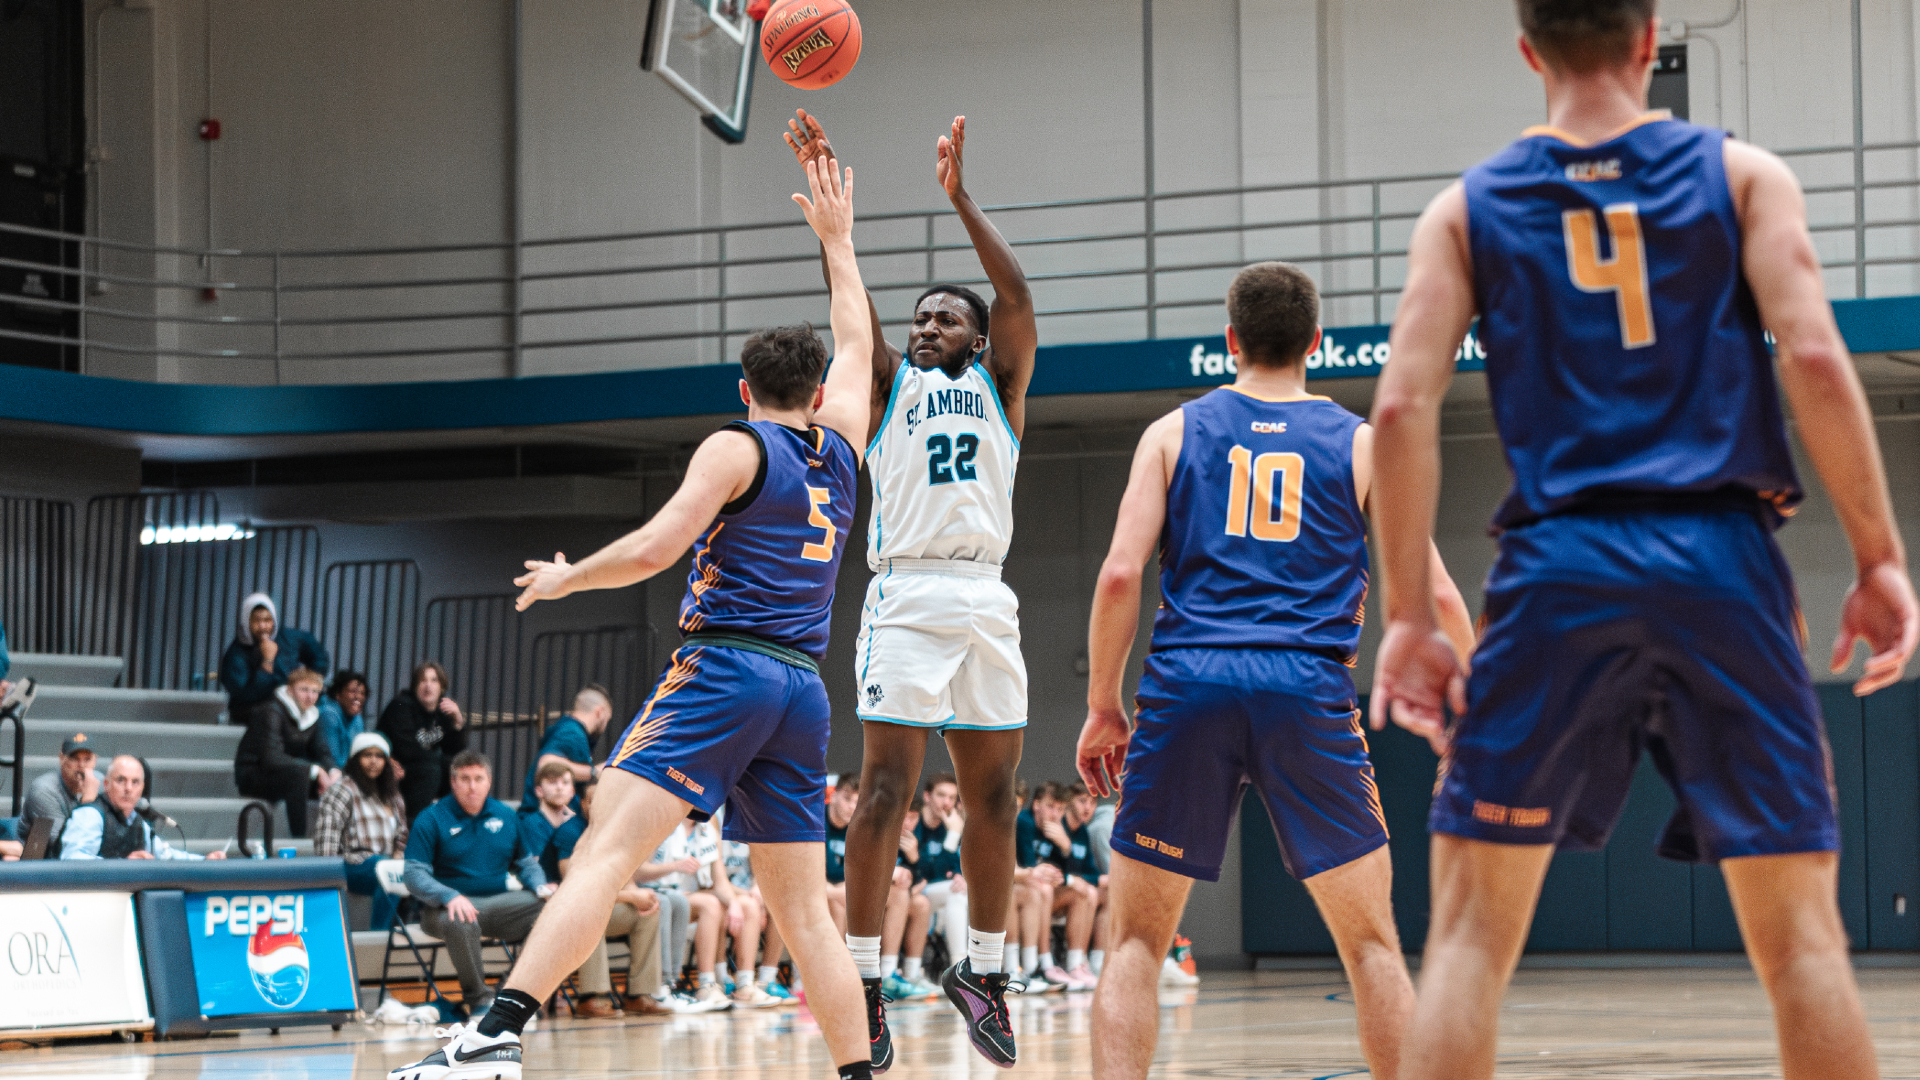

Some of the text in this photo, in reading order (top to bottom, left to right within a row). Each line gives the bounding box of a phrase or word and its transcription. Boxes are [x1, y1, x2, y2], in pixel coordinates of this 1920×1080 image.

[764, 3, 820, 52] SPALDING
[781, 27, 835, 75] NAIA
[1561, 202, 1657, 350] 4
[926, 388, 989, 422] AMBRO
[926, 432, 981, 487] 22
[1225, 444, 1305, 542] 10
[801, 482, 837, 563] 5
[666, 765, 706, 796] TIGER TOUGH
[1135, 832, 1184, 859] TIGER TOUGH
[205, 894, 304, 937] PEPSI
[8, 926, 81, 979] ORA
